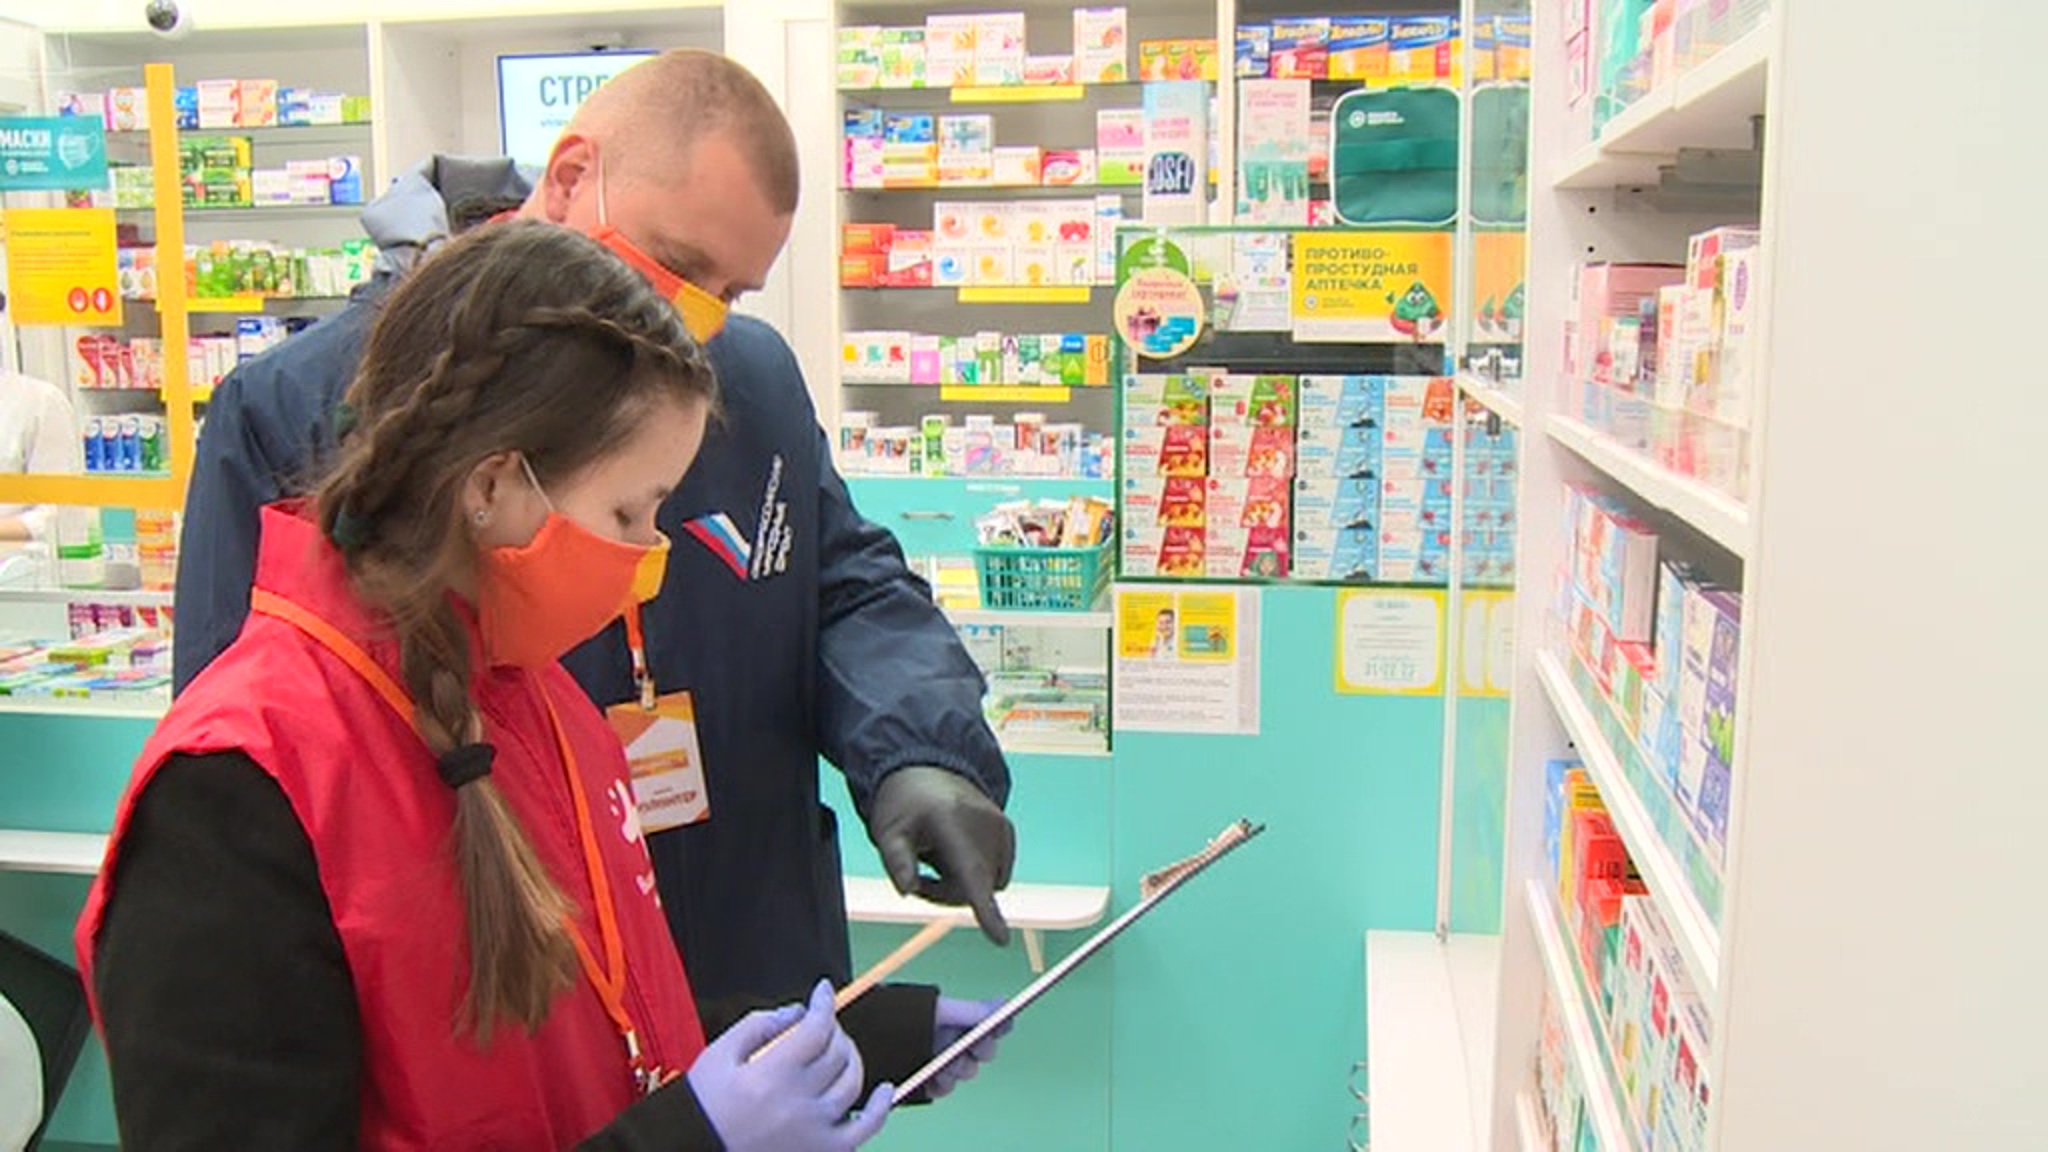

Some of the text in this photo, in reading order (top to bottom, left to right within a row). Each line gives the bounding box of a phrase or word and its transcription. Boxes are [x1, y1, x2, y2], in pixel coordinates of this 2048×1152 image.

[1305, 247, 1390, 259] ПРОТИВО-
[1305, 263, 1418, 276] ПРОСТУДНАЯ
[1305, 279, 1383, 290] АПТЕЧКА
